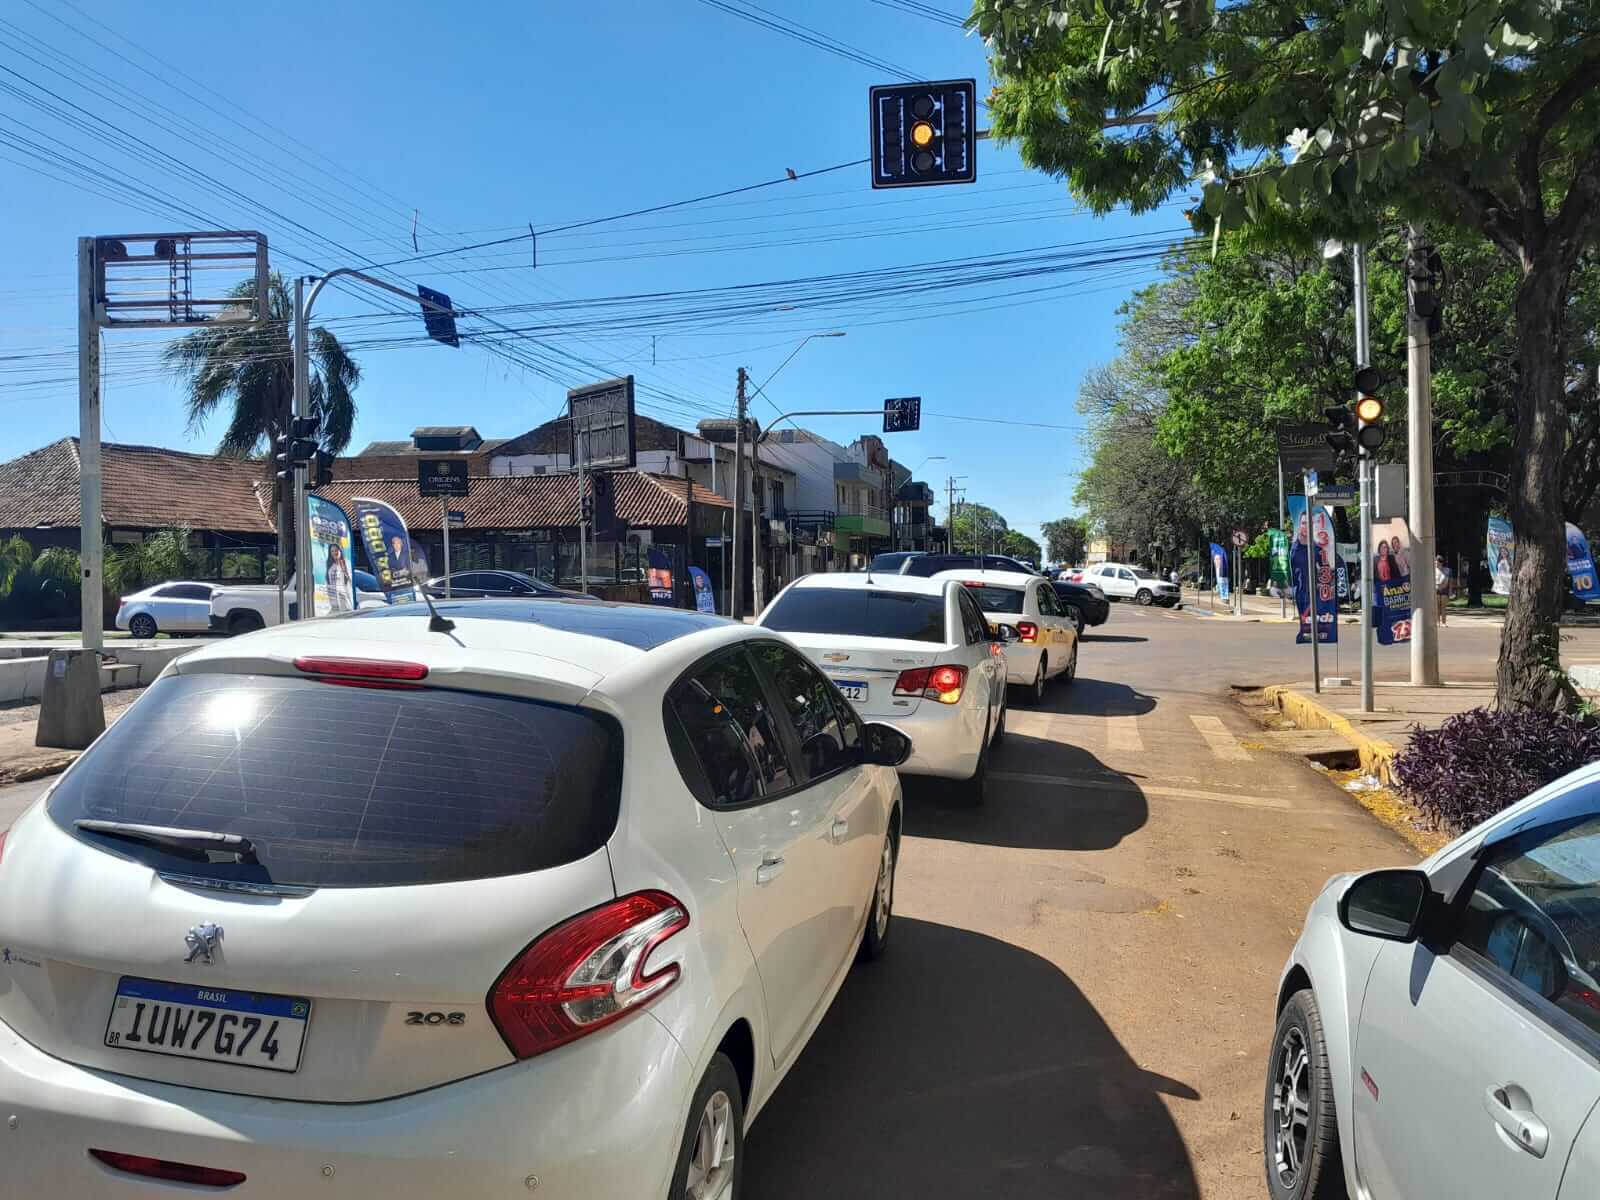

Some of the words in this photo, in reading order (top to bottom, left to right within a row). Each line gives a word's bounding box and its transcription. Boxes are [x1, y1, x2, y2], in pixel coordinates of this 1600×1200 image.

[196, 990, 229, 1004] BRASIL
[405, 1011, 466, 1026] 208
[108, 1032, 121, 1045] BR
[126, 1002, 280, 1062] IUW7G74
